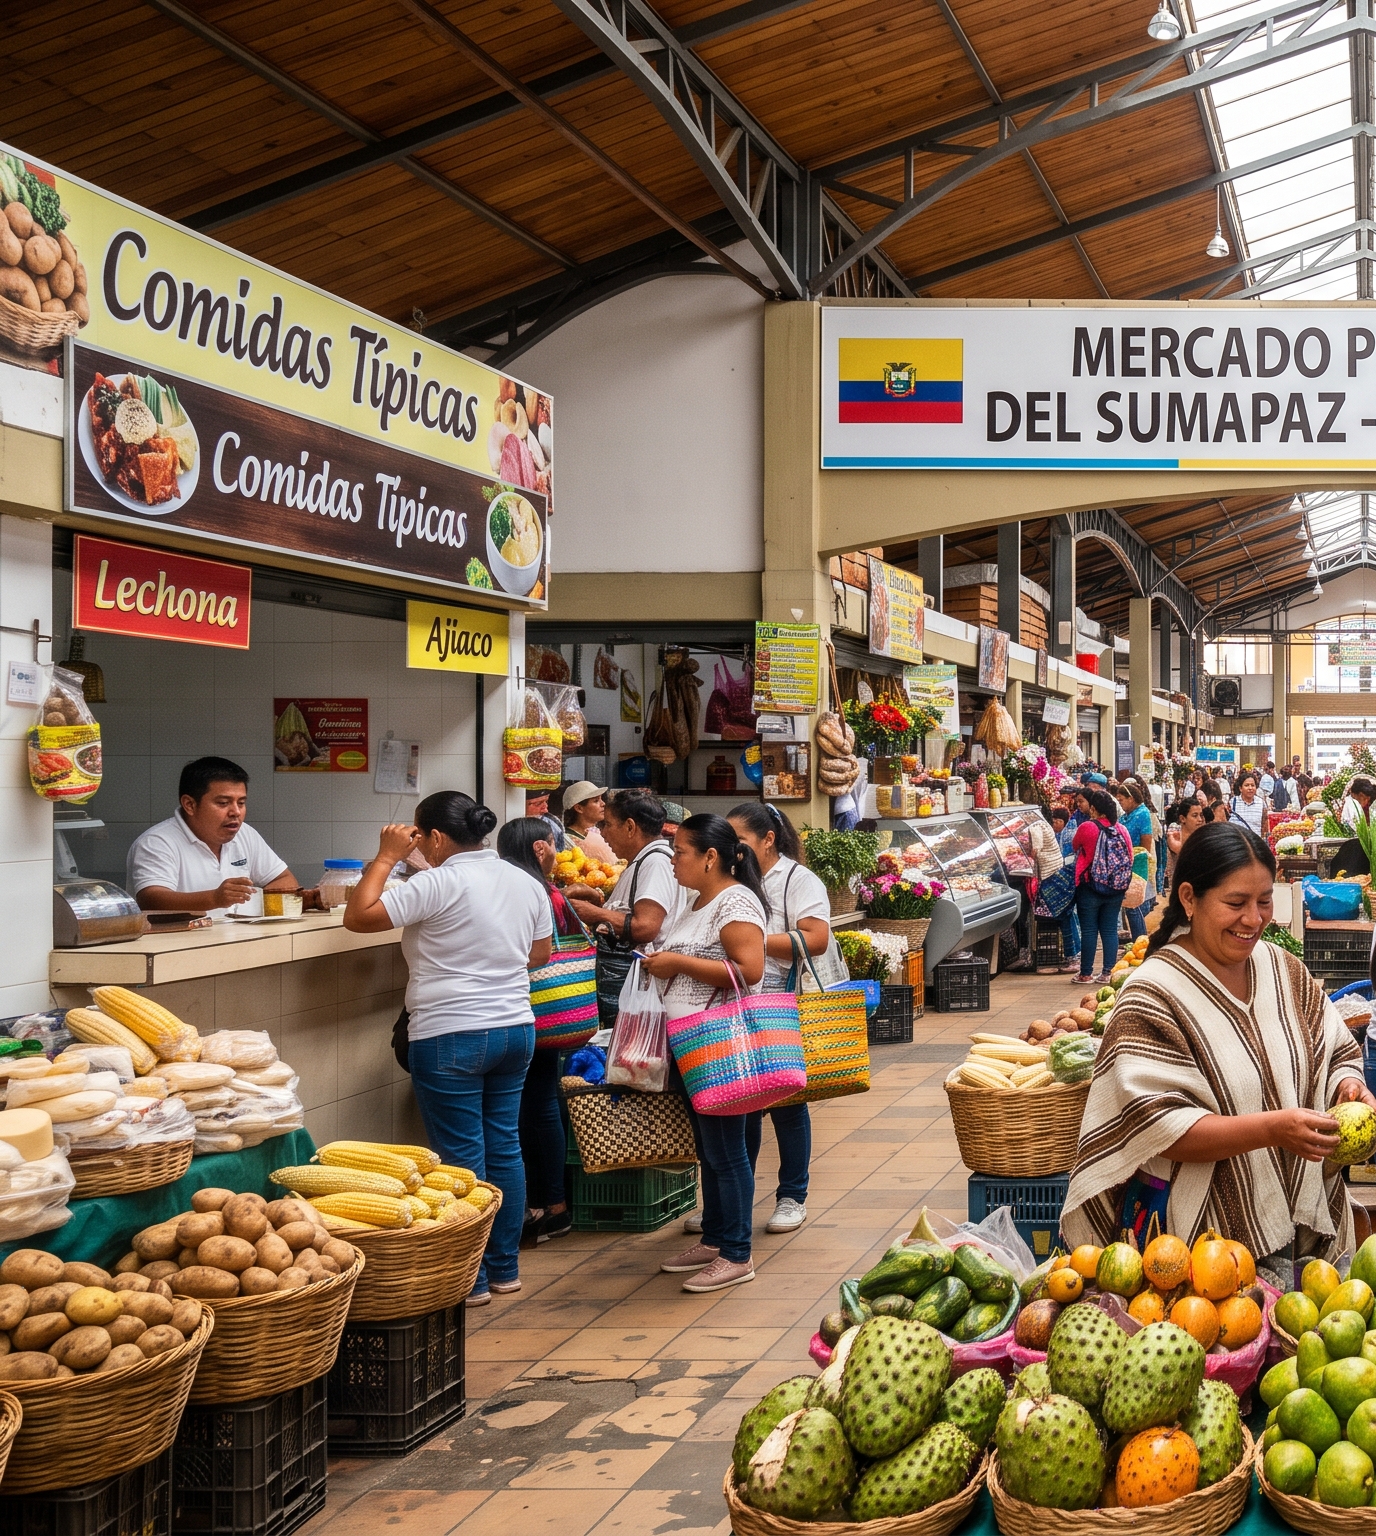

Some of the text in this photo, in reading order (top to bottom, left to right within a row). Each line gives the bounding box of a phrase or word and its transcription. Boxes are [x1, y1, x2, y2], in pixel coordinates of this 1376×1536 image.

[103, 230, 479, 443] Comidas Típicas
[1072, 326, 1331, 379] MERCADO
[986, 390, 1081, 443] DEL
[1096, 390, 1347, 444] SUMAPAZ
[1361, 418, 1376, 427] -
[212, 431, 468, 549] Comidas Típicas
[94, 559, 239, 629] Lechona
[425, 616, 493, 663] Ajiaco
